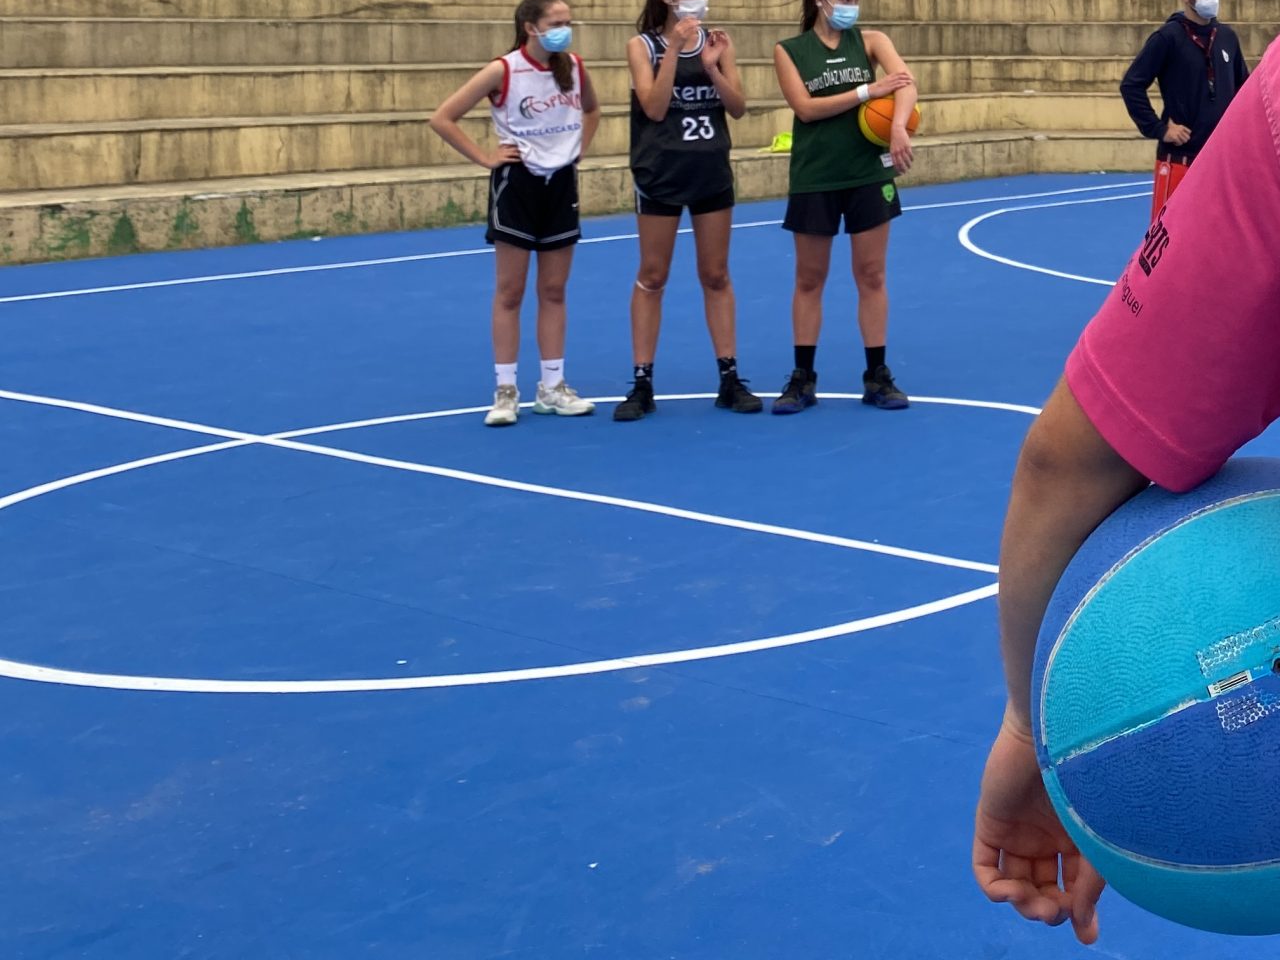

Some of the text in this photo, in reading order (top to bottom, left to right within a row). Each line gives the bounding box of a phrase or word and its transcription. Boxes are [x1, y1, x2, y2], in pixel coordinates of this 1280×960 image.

[805, 75, 825, 93] AMPUS
[839, 67, 864, 84] MIGUEL
[682, 116, 715, 141] 23
